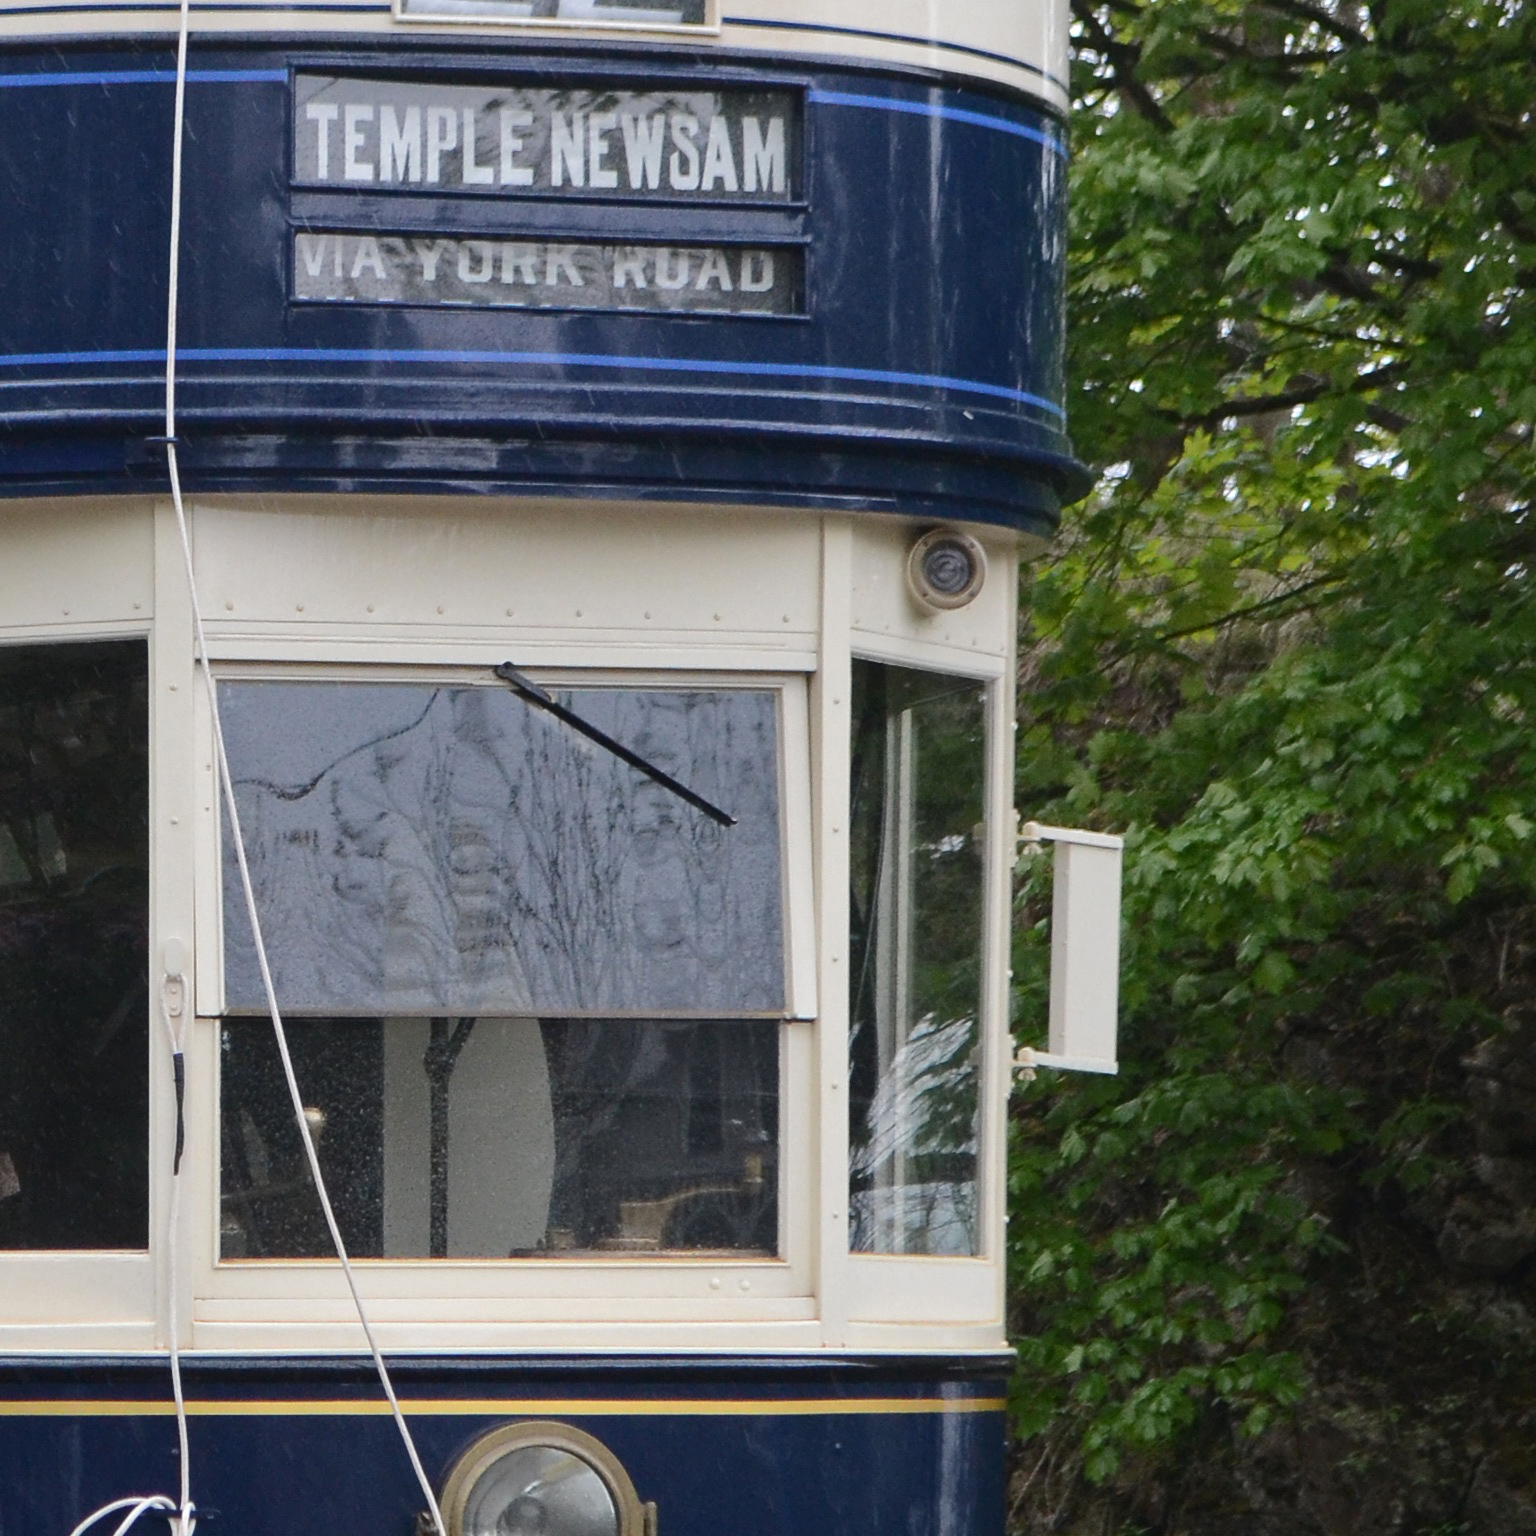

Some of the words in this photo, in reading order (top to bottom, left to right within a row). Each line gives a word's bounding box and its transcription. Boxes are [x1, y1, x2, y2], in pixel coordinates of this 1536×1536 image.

[306, 103, 535, 187] TEMPLE
[550, 112, 787, 193] NEWSAM
[300, 234, 387, 280] VIA
